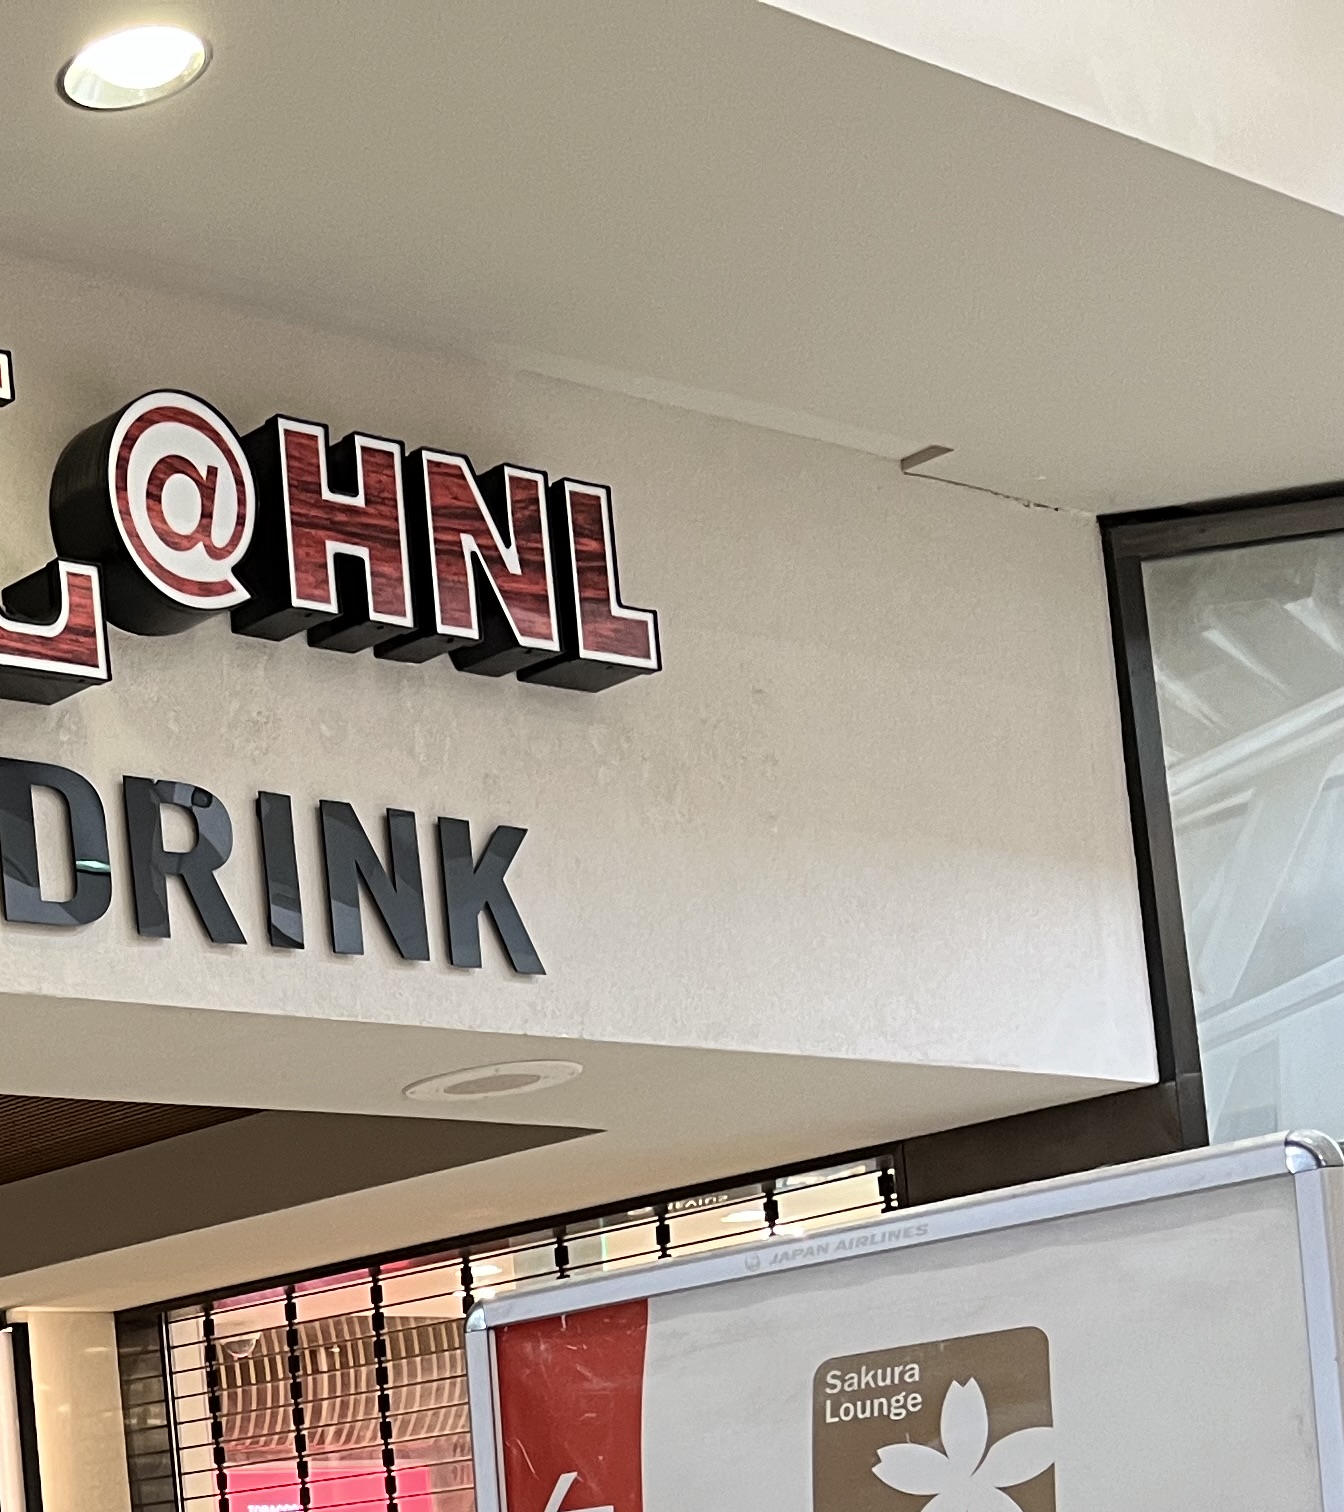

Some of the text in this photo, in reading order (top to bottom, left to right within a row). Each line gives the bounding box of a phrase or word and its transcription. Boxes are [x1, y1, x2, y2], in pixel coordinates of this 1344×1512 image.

[769, 1223, 929, 1267] JAPAN AIRLINES
[825, 1363, 920, 1394] Sakura
[825, 1392, 923, 1423] Lounge
